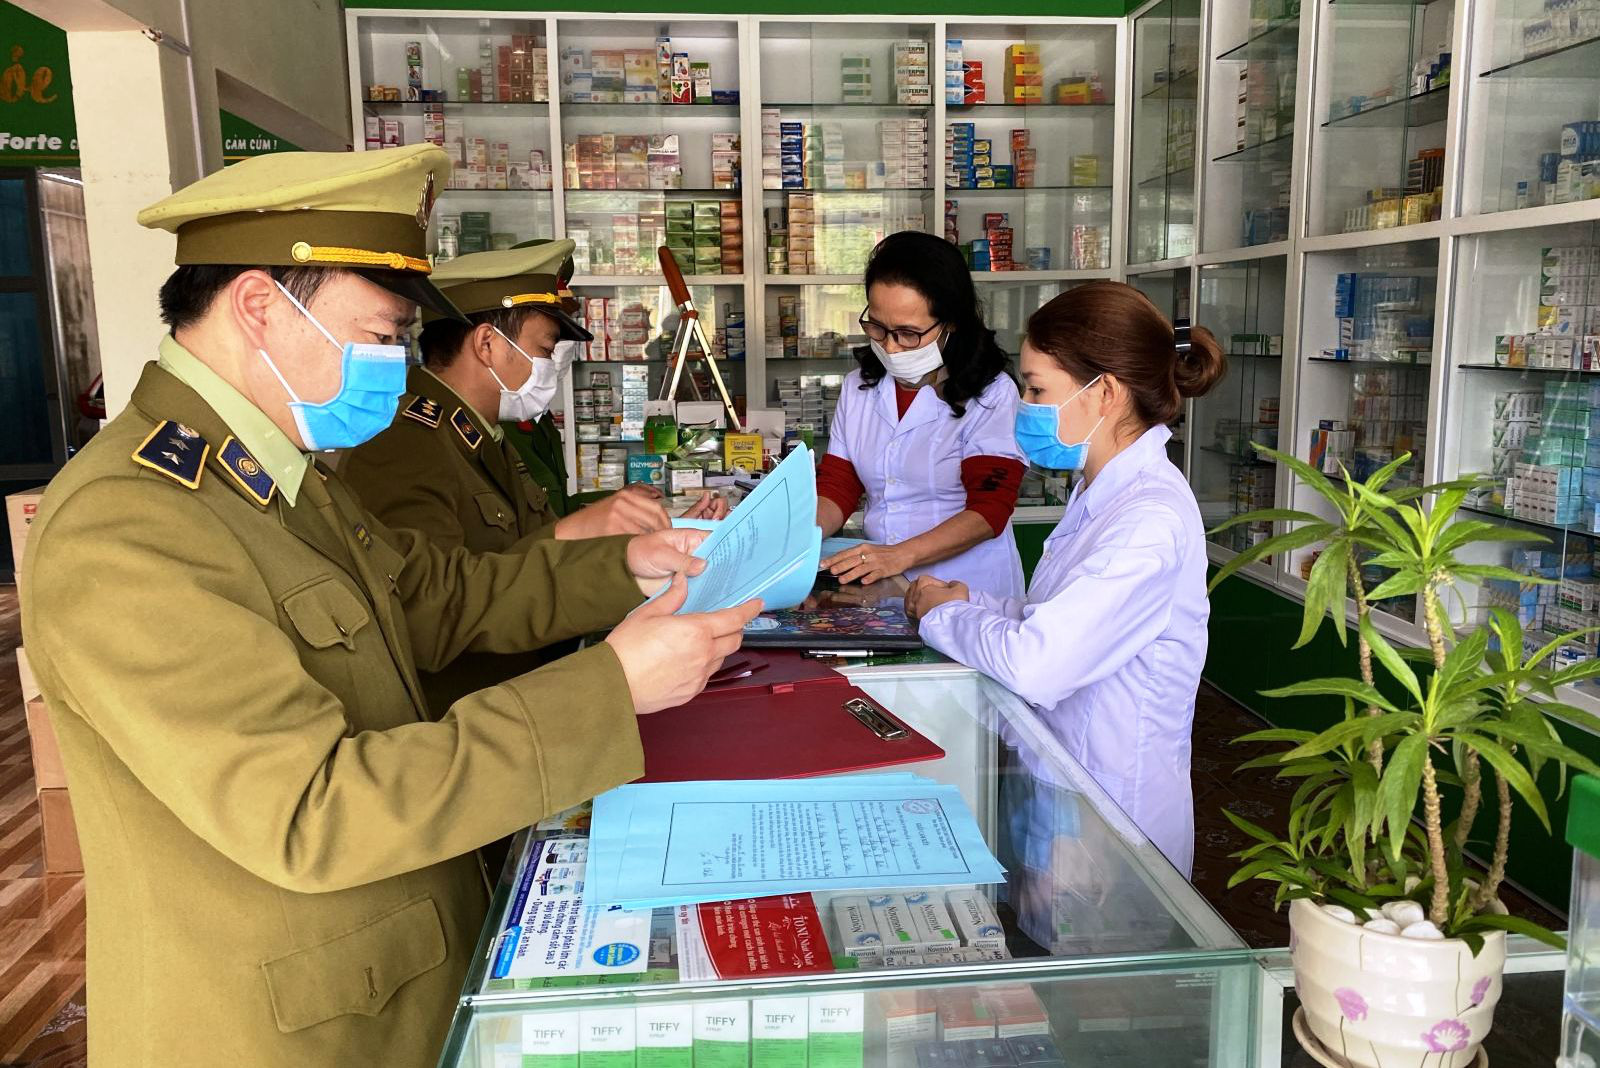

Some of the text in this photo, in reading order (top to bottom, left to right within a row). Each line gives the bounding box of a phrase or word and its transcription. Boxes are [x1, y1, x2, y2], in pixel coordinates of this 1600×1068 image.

[0, 133, 62, 149] Forte
[250, 134, 270, 149] CÚM
[566, 926, 578, 934] hết
[549, 941, 561, 949] sốt
[546, 951, 555, 960] sau
[821, 1008, 850, 1016] TIFFY
[706, 1016, 735, 1025] TIFFY
[765, 1015, 795, 1023] TIFFY
[592, 1027, 622, 1035] TIFFY
[649, 1022, 680, 1031] TIFFY
[534, 1029, 564, 1038] TIFFY
